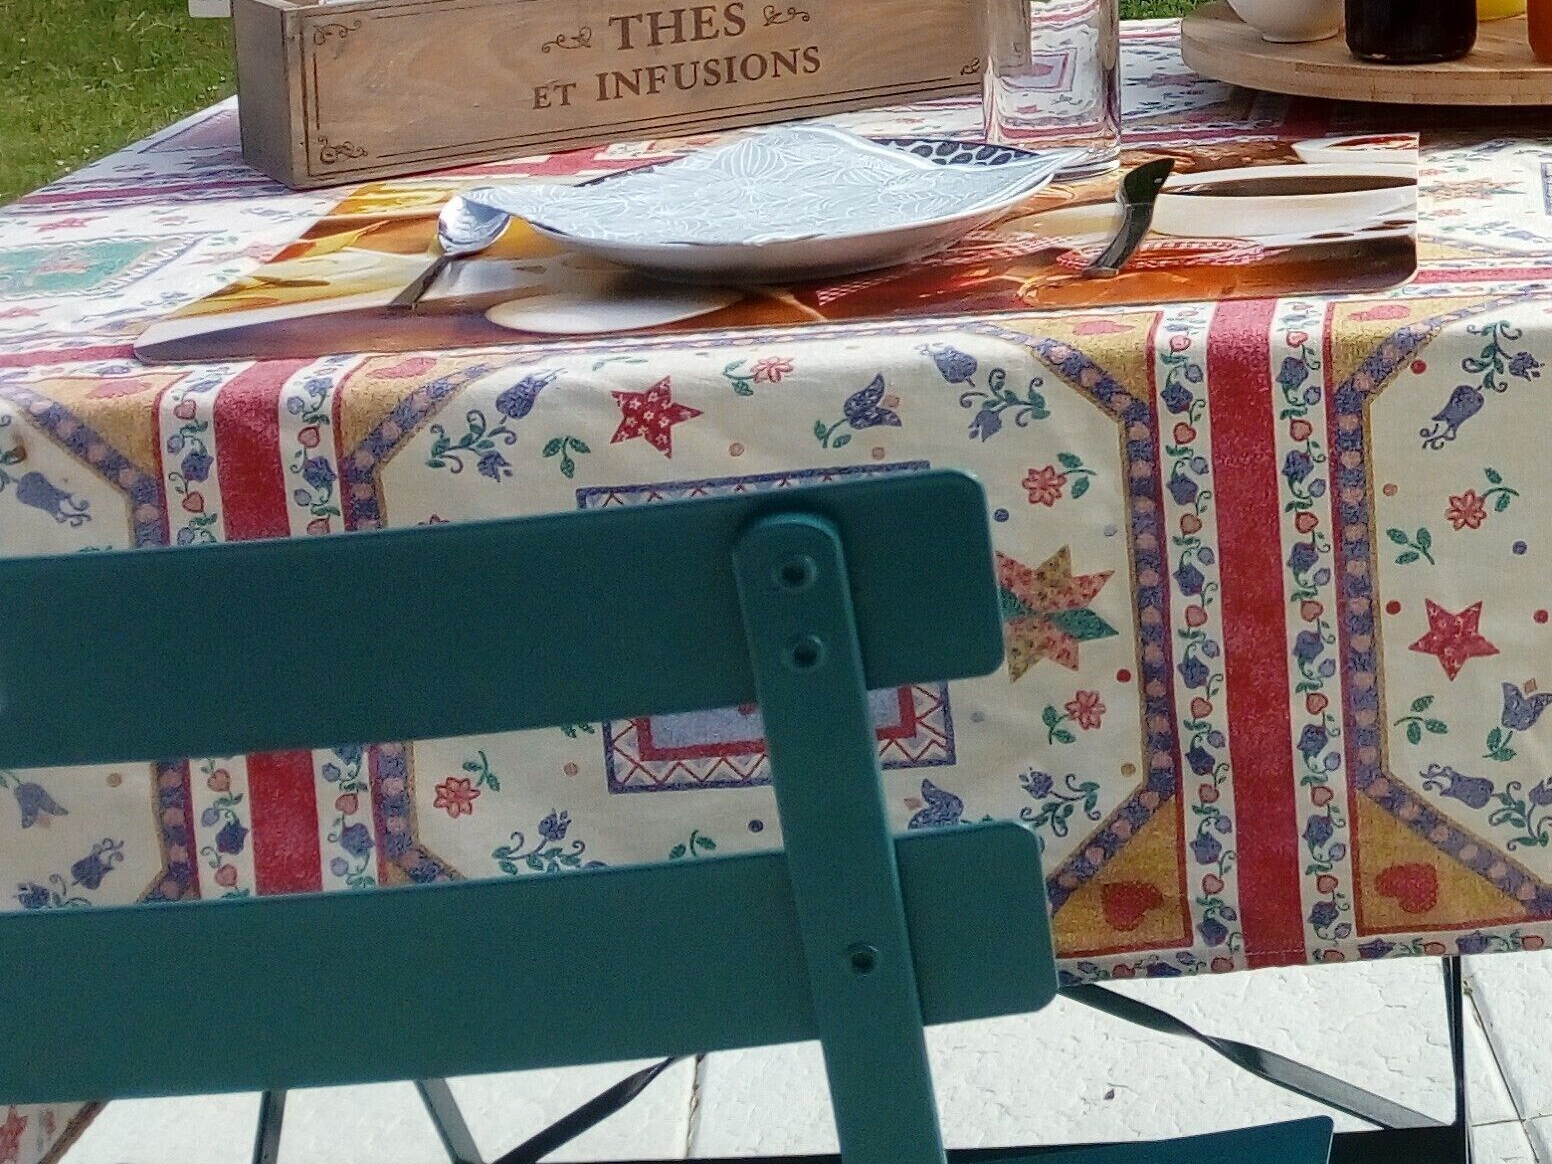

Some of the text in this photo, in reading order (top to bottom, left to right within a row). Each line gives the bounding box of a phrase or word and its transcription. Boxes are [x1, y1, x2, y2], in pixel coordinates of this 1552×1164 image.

[608, 1, 747, 51] THES
[532, 45, 822, 110] ET INFUSIONS
